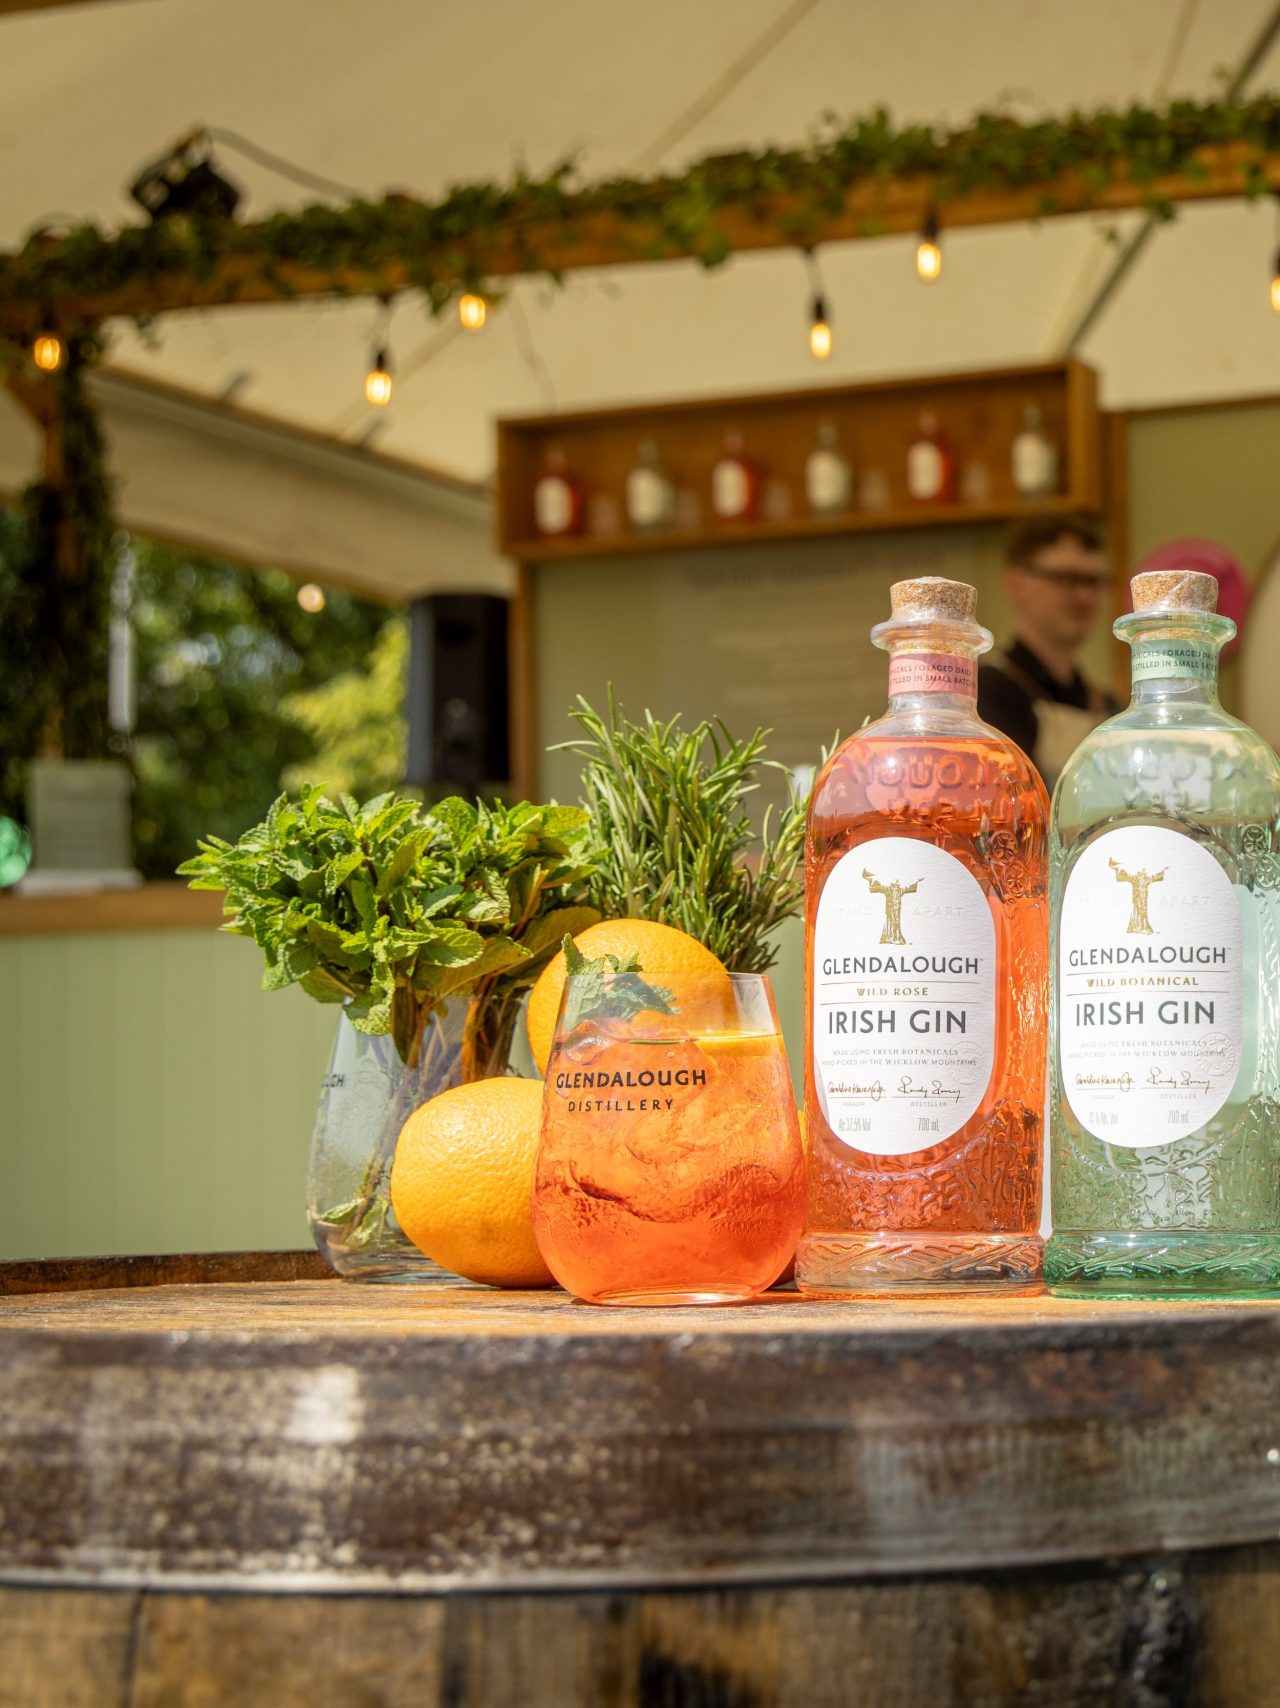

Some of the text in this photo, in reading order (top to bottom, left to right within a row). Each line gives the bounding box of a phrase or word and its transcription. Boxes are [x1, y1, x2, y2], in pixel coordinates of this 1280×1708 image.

[1162, 649, 1201, 658] FORAGED
[914, 664, 954, 673] FORAGED
[925, 675, 952, 683] SMALL
[1069, 946, 1226, 967] GLENDALOUGH
[822, 956, 979, 976] GLENDALOUGH
[1086, 976, 1199, 987] WILD BOTANICAL
[856, 986, 929, 997] WILD ROSE
[1075, 1000, 1215, 1027] IRISH GIN
[828, 1009, 966, 1035] IRISH GIN
[931, 1058, 977, 1066] MOUNTAINS
[556, 1069, 707, 1089] GLENDALOUGH
[568, 1098, 674, 1112] DISTILLERY
[917, 1117, 930, 1132] 700
[1168, 1110, 1179, 1125] 700
